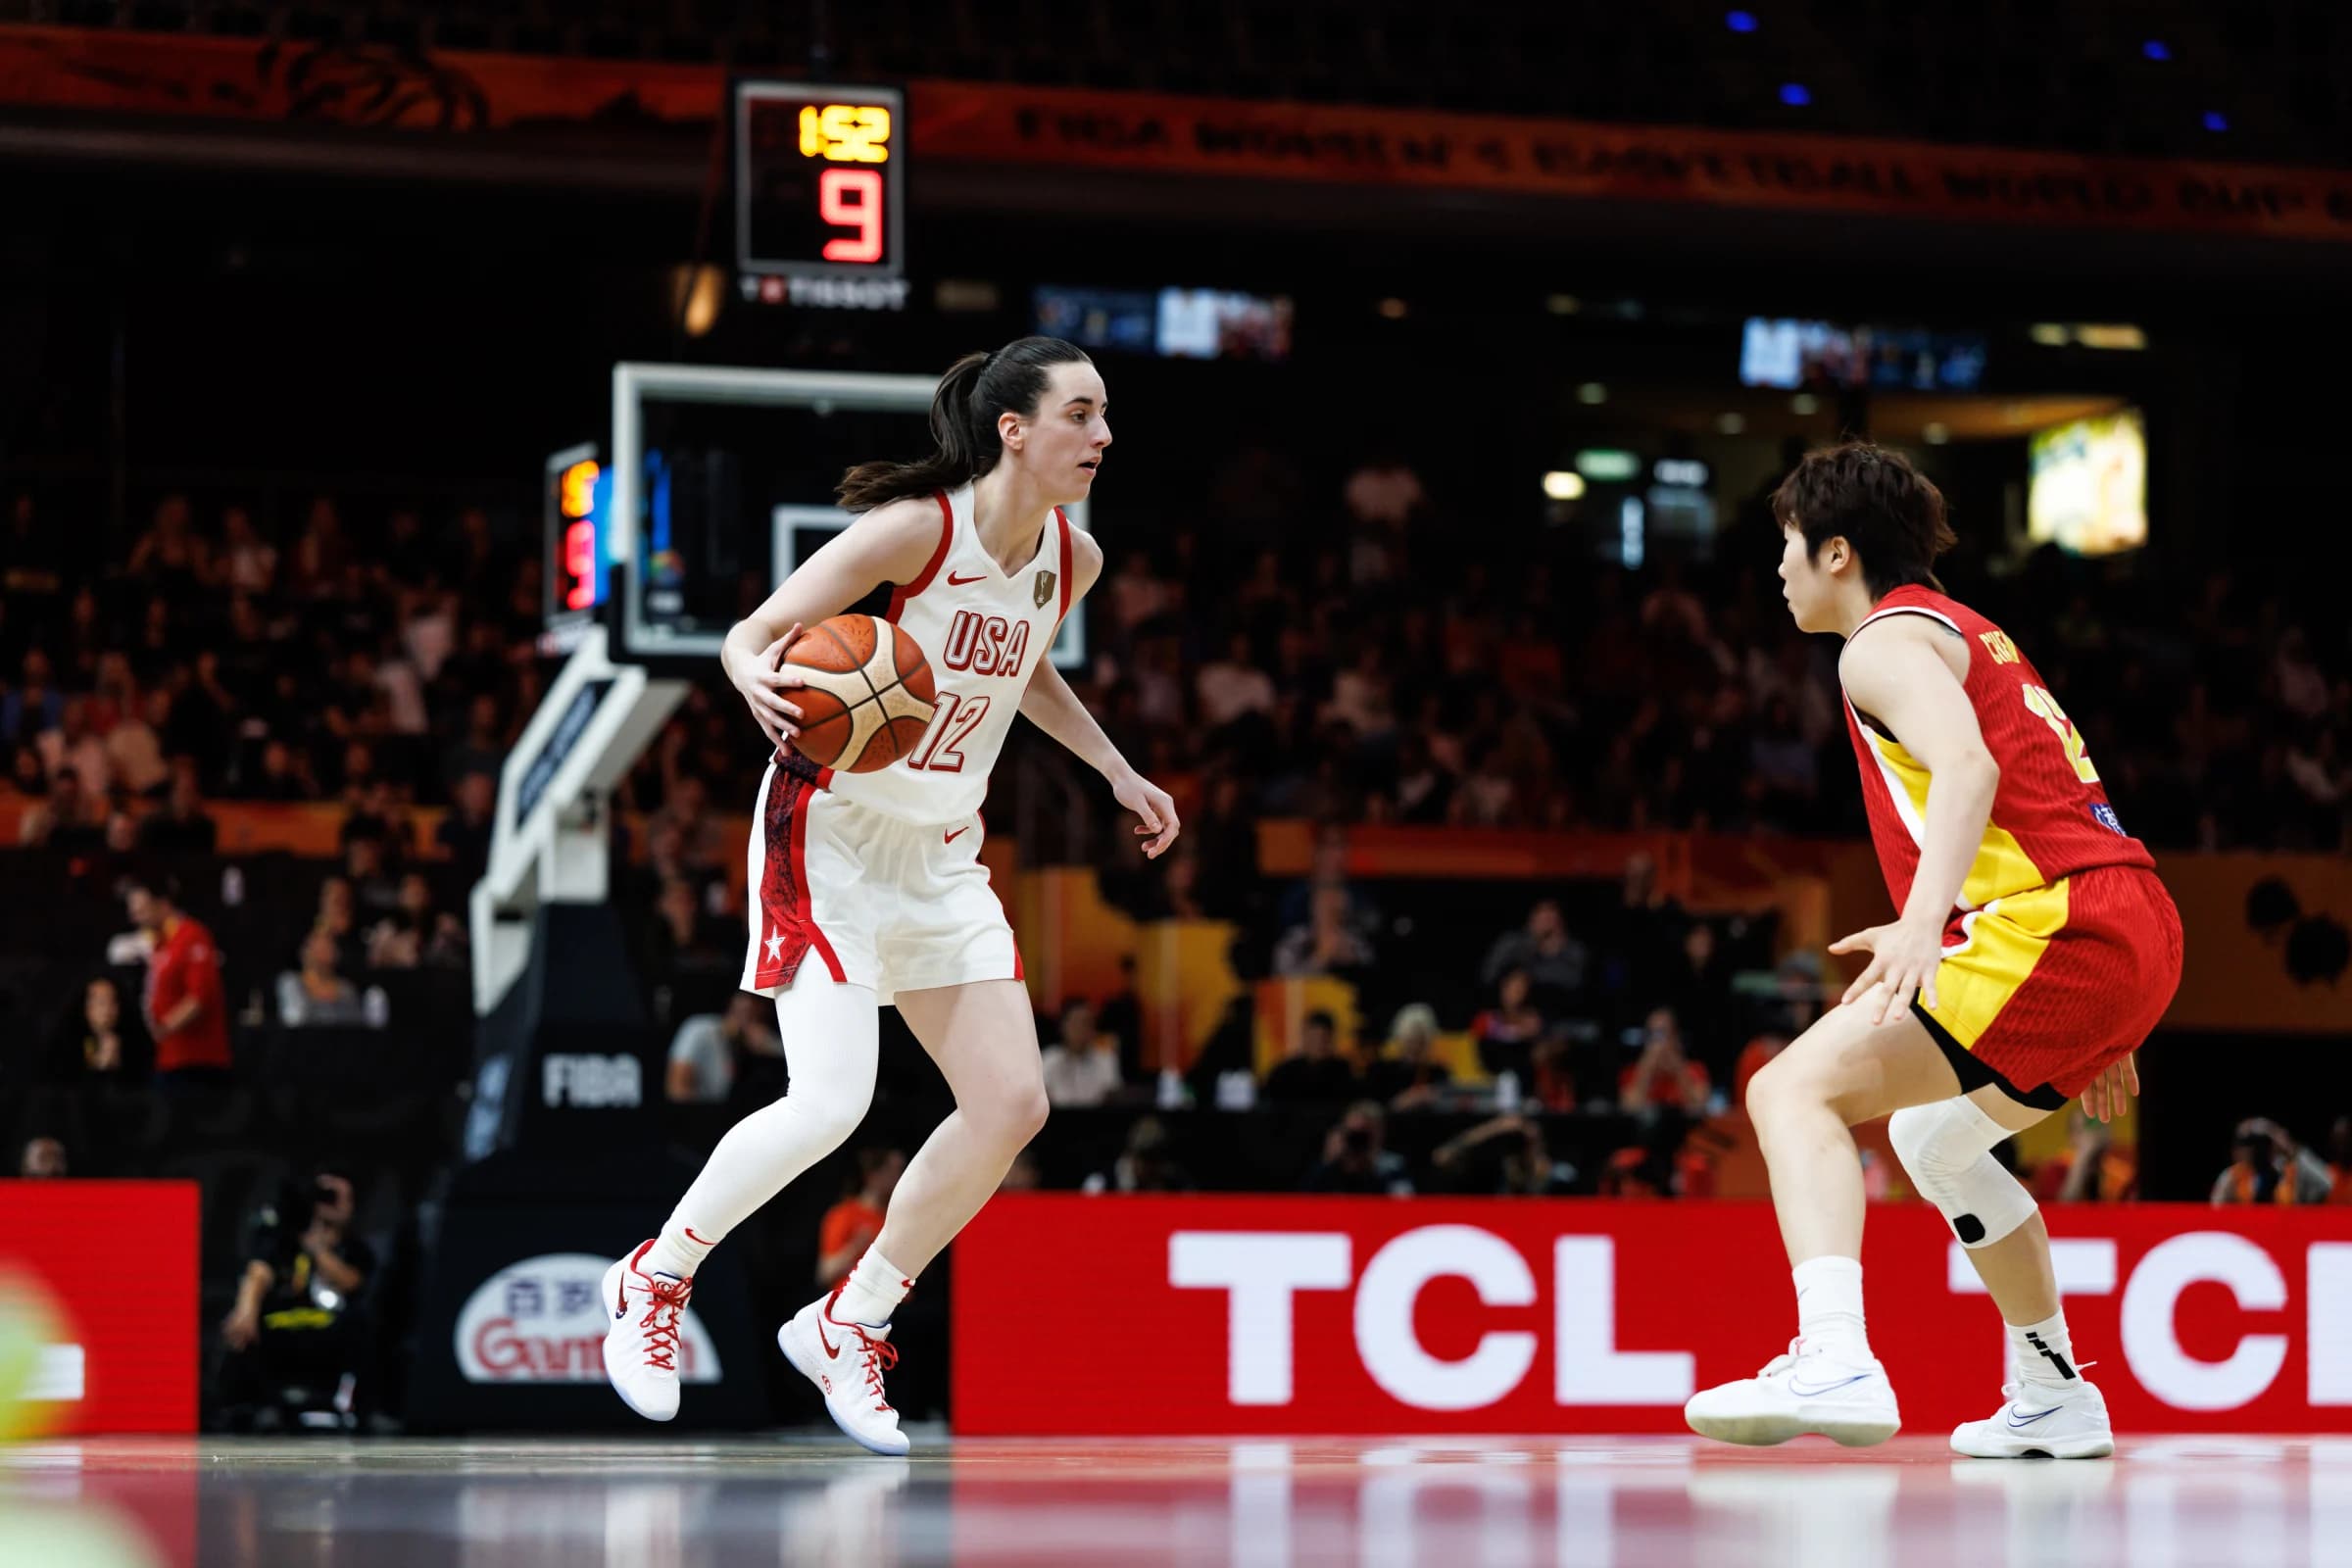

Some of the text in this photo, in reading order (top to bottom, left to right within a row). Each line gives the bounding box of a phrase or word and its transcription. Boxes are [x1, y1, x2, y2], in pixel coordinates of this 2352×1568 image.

[819, 168, 882, 263] 9
[944, 610, 1030, 677] USA
[906, 691, 991, 772] 12
[542, 1053, 643, 1107] FIBA
[1168, 1224, 1695, 1411] TCL
